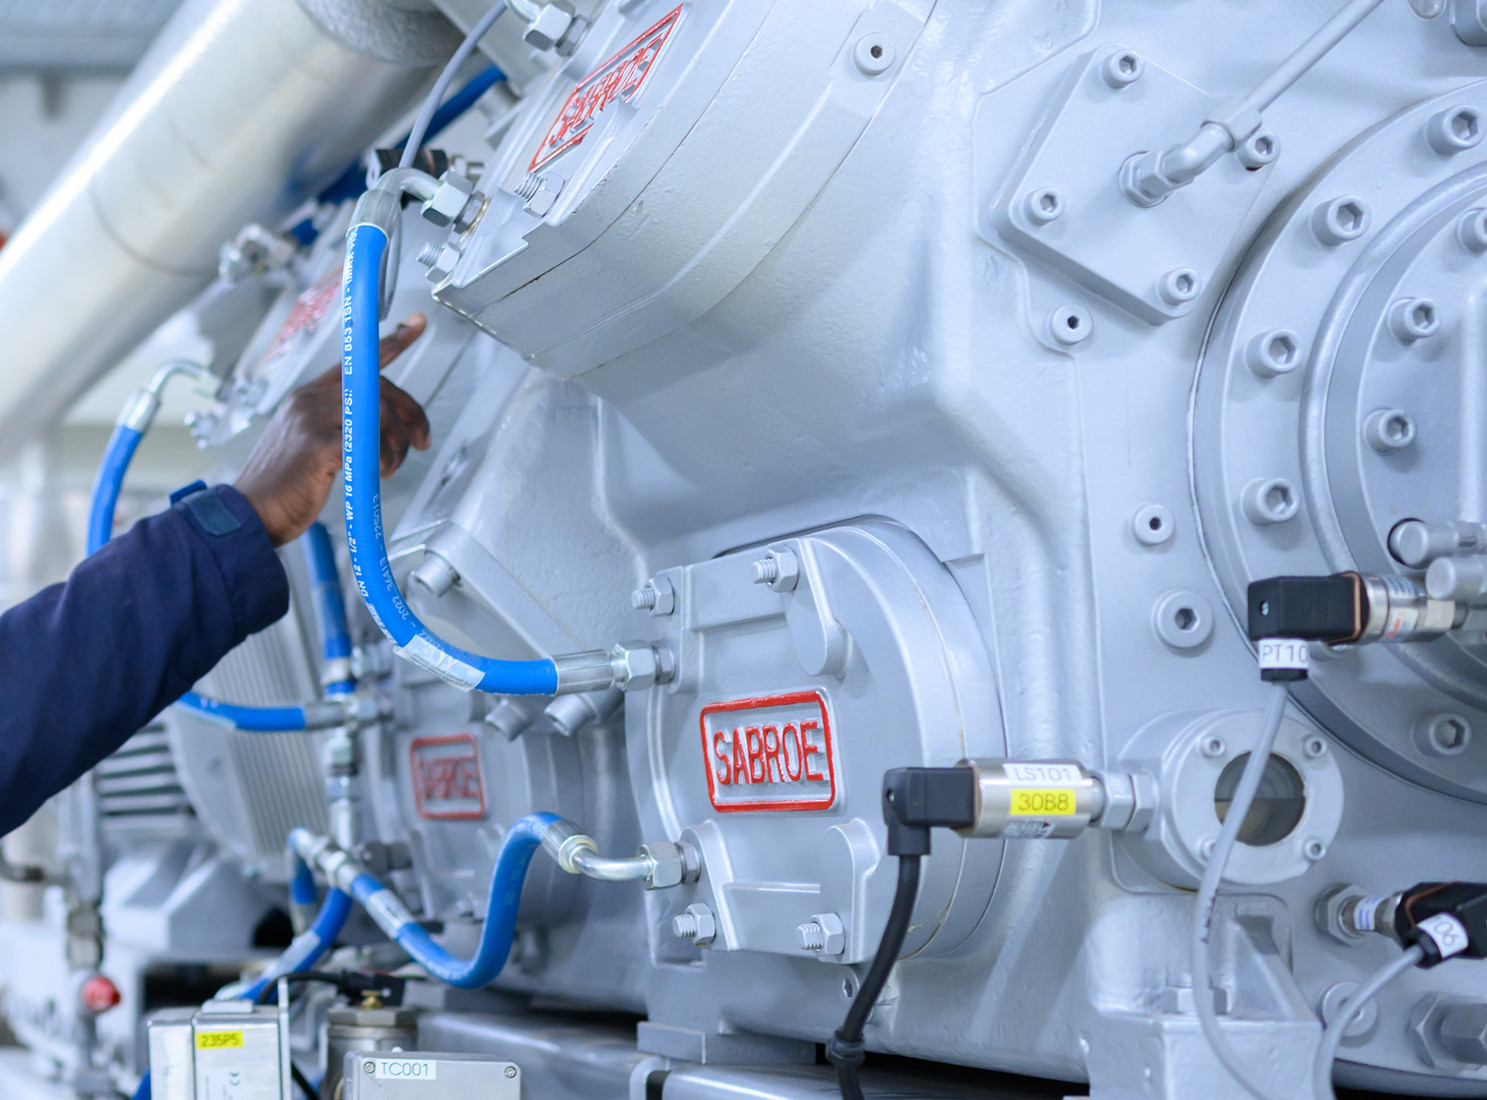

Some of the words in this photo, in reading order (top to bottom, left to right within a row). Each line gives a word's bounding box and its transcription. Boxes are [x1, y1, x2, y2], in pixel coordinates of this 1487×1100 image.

[344, 296, 352, 322] 1SN
[344, 327, 353, 352] 853
[344, 356, 353, 375] EN
[344, 419, 353, 452] (2320
[344, 456, 353, 482] MPa
[345, 484, 353, 497] 16
[345, 501, 354, 520] WP
[353, 564, 362, 576] 12
[358, 580, 369, 597] DN
[713, 720, 824, 785] SABROE
[1013, 767, 1072, 781] LS101
[1018, 793, 1070, 812] 30B8
[200, 1033, 240, 1048] 235P5
[381, 1062, 429, 1077] TC001
